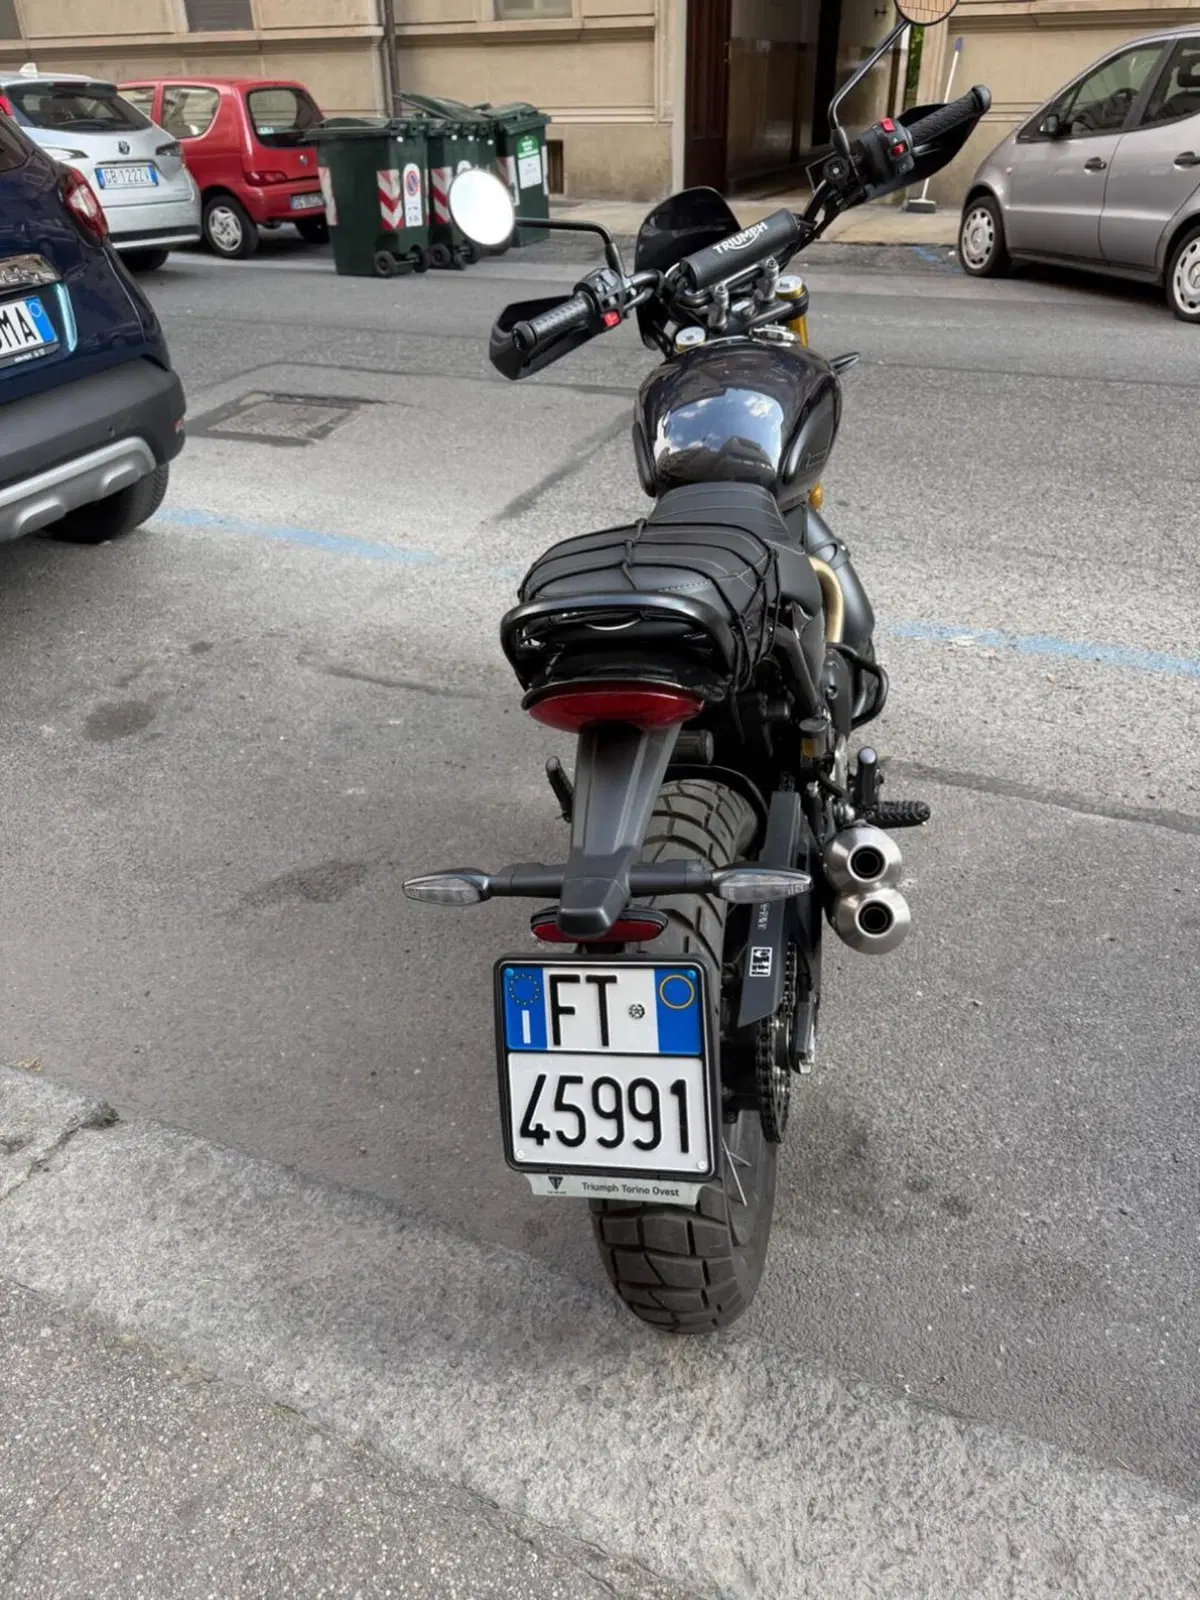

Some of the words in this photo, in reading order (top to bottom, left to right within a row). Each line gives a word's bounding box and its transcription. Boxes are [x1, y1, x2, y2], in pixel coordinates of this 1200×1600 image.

[712, 221, 768, 254] TRIUMPH
[0, 306, 37, 349] MA
[549, 974, 618, 1047] FT
[519, 1073, 690, 1154] 45991
[581, 1181, 619, 1193] Triumph
[622, 1184, 650, 1195] Torino
[652, 1186, 680, 1197] Ovest
